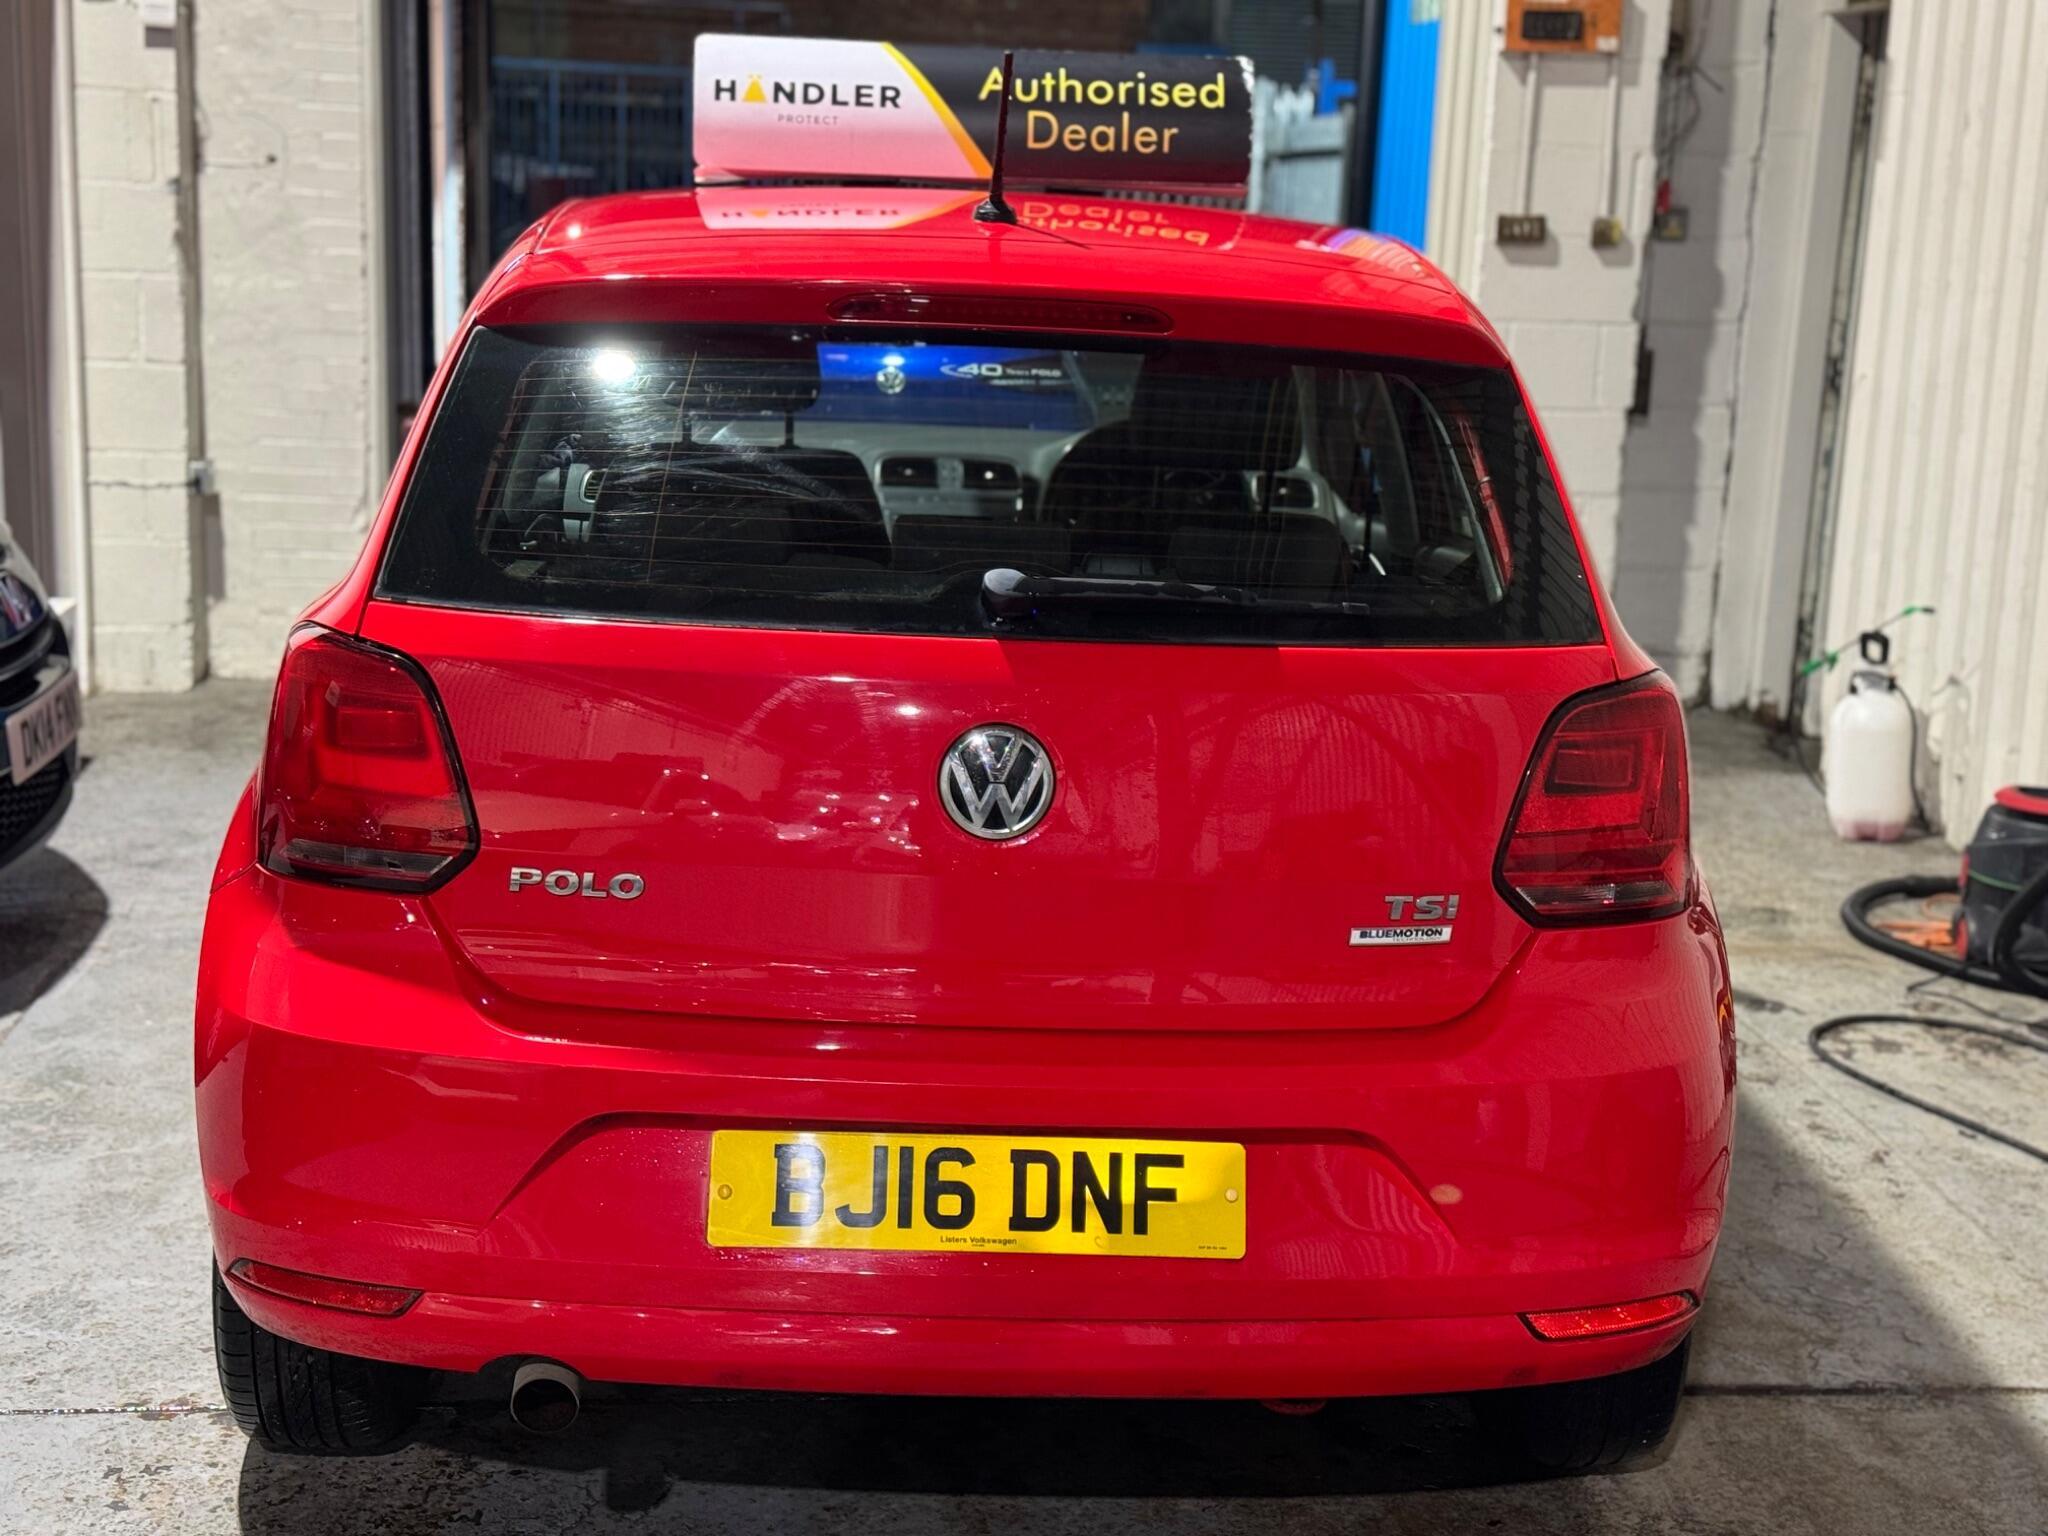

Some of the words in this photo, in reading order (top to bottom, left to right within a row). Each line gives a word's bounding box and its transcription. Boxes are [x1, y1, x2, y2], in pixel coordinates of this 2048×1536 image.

[978, 66, 1226, 109] Authorised
[777, 113, 839, 126] PROTECT
[1027, 110, 1180, 154] Dealer
[509, 866, 645, 899] POLO
[1384, 895, 1460, 920] TSI
[1359, 928, 1443, 939] BLUEMOTION
[771, 1143, 976, 1230] BJ16
[1008, 1149, 1185, 1235] DNF
[940, 1235, 967, 1243] Listers
[969, 1236, 1018, 1245] Volkswagen
